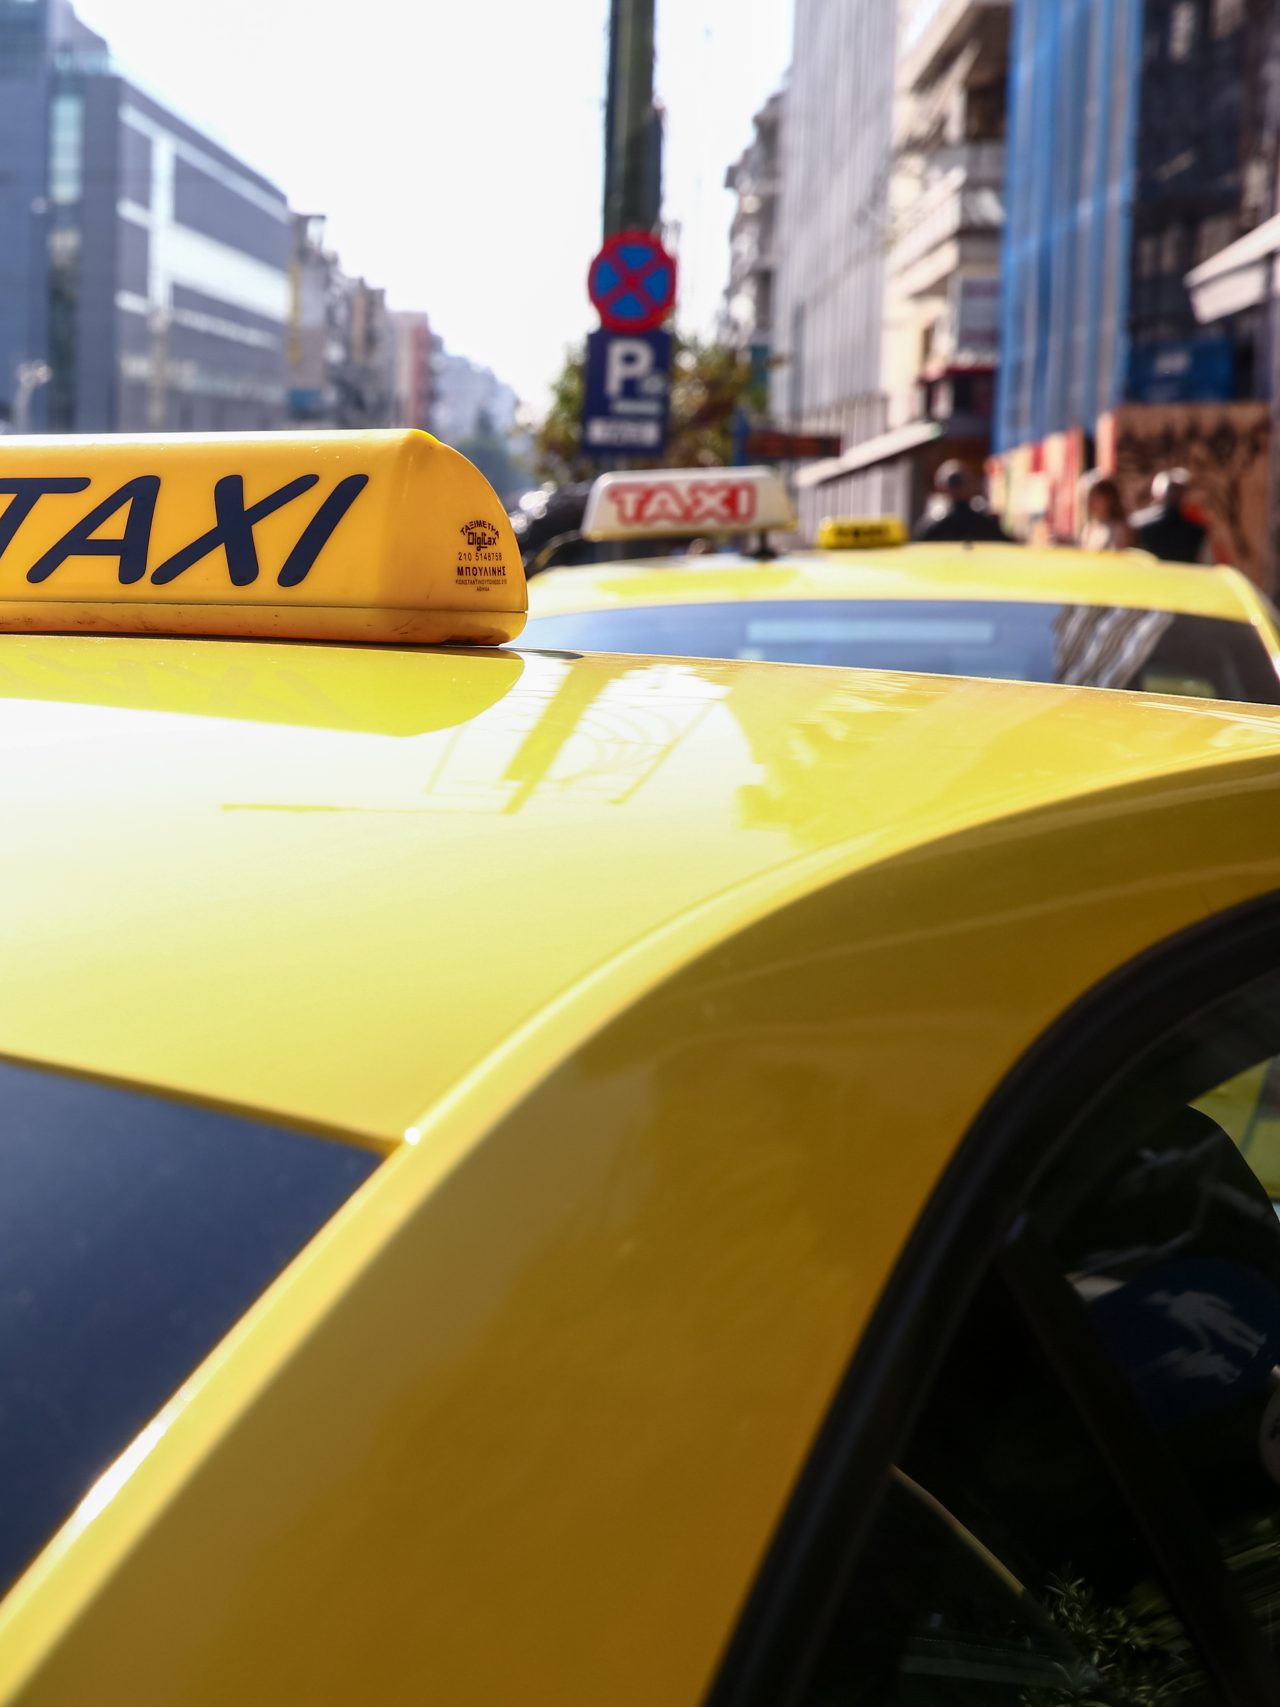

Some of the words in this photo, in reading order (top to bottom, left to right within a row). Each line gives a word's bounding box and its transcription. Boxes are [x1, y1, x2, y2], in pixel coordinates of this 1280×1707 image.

[605, 339, 655, 399] P
[609, 482, 757, 526] TAXI
[458, 552, 472, 561] 210
[457, 566, 506, 577] ΜΠΟΥΛΙΝΗΣ
